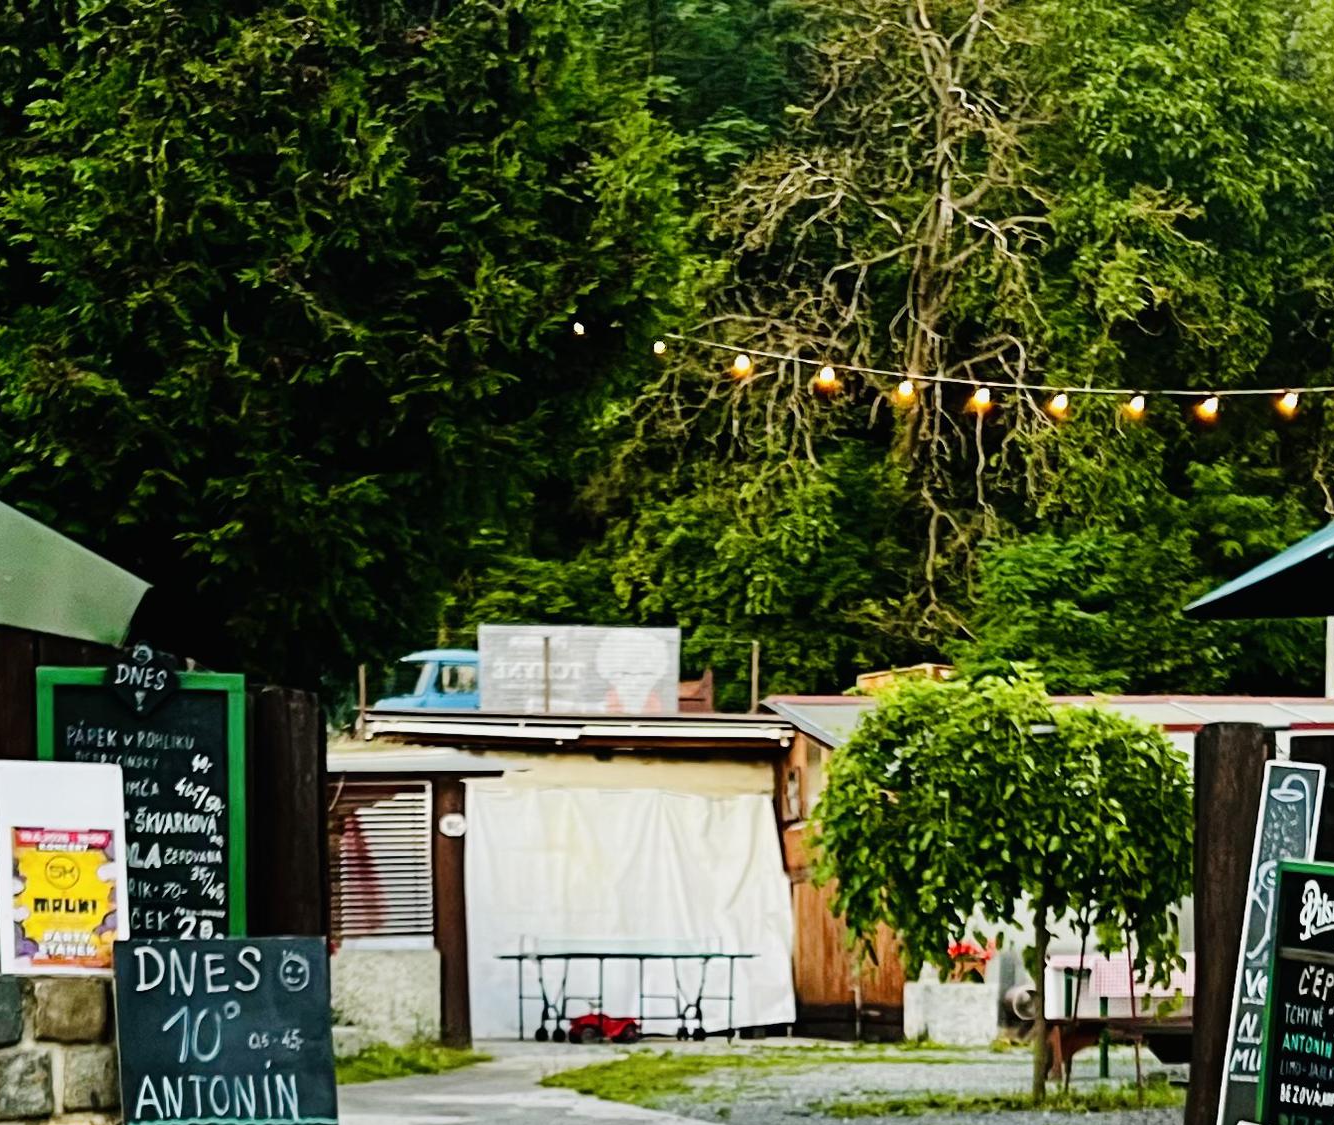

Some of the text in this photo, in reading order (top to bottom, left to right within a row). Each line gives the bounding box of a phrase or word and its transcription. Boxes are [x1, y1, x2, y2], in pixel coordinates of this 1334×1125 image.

[115, 664, 167, 690] DNES
[134, 946, 262, 996] DNES
[162, 1000, 241, 1064] 10°
[1282, 1031, 1333, 1059] ANTONÍN
[135, 1060, 300, 1121] ANTONÍN
